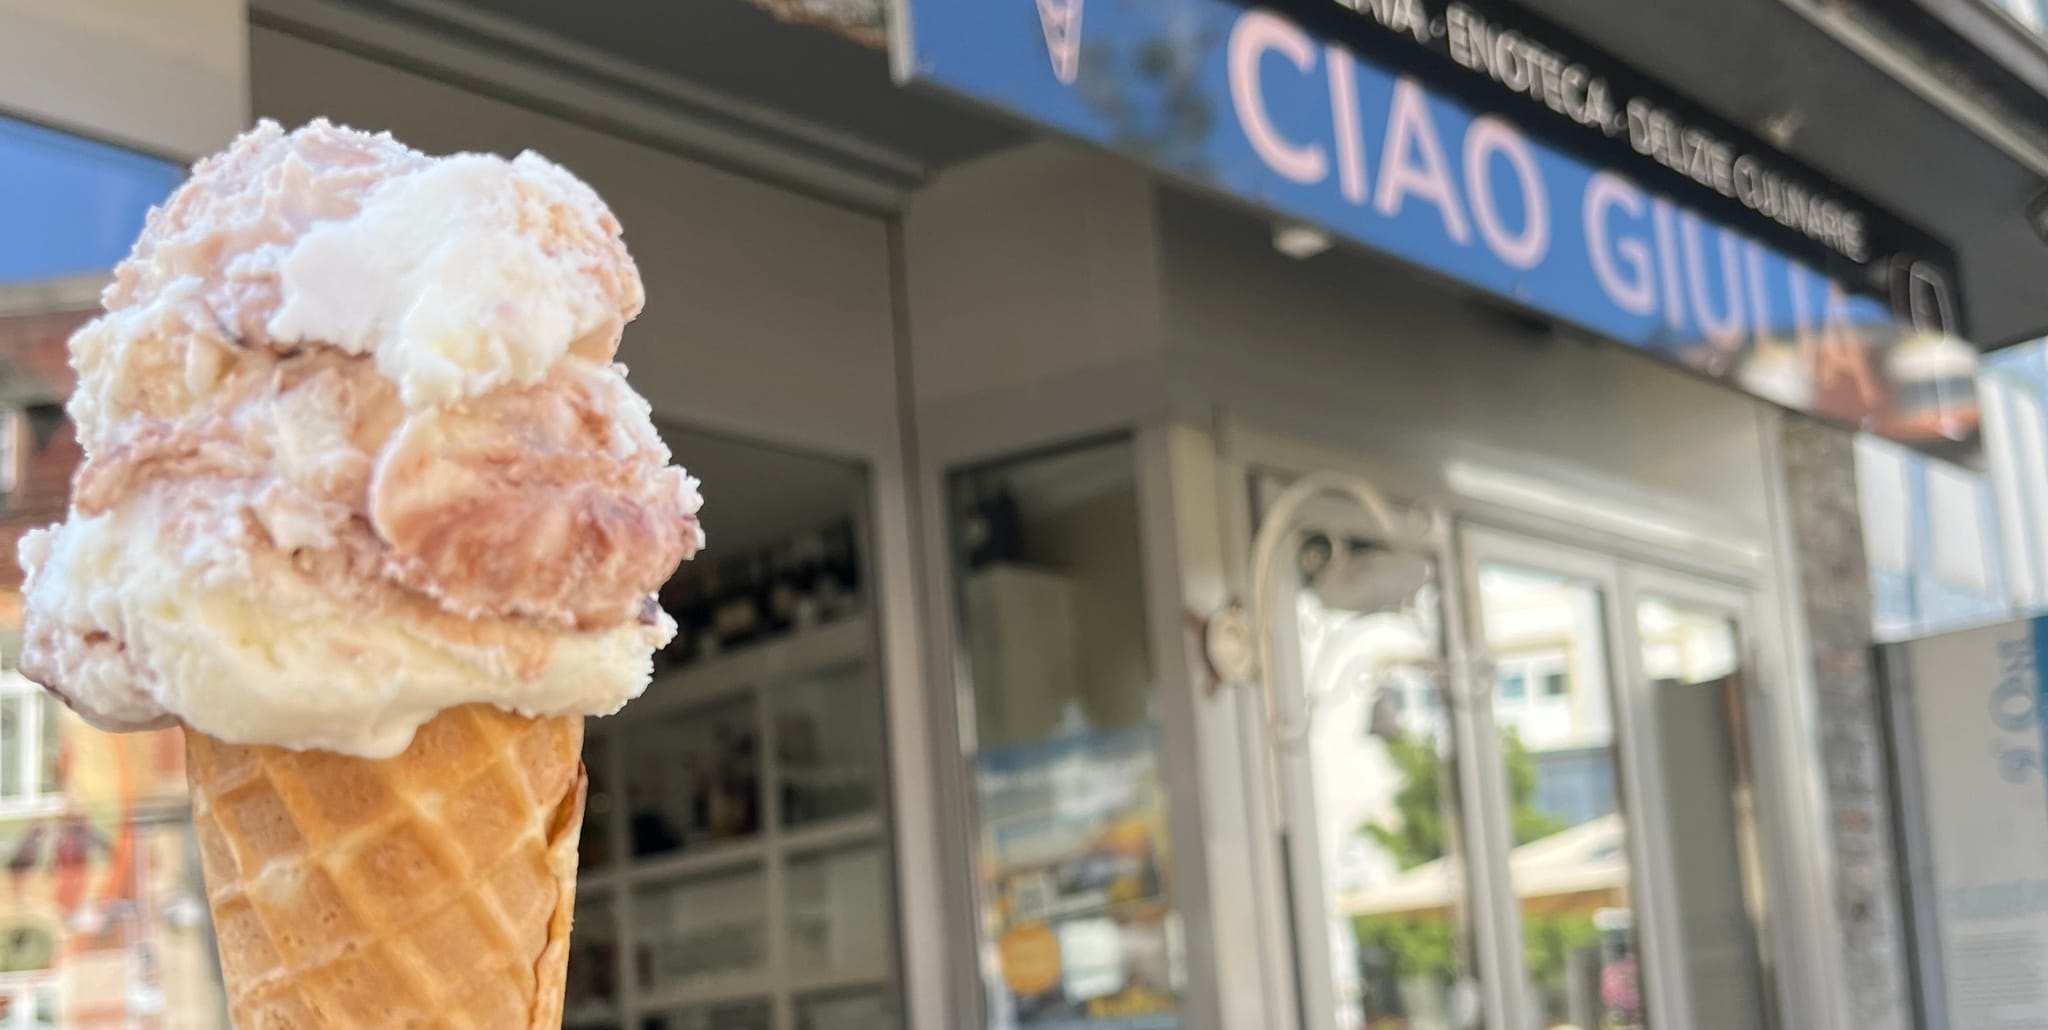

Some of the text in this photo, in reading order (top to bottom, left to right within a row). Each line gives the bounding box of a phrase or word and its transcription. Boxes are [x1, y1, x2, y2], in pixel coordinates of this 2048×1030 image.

[1227, 11, 1550, 271] CIAO
[1447, 2, 1616, 137] ENOTECA
[1626, 96, 1736, 199] DELIZIE
[1733, 153, 1869, 264] CULINARIE
